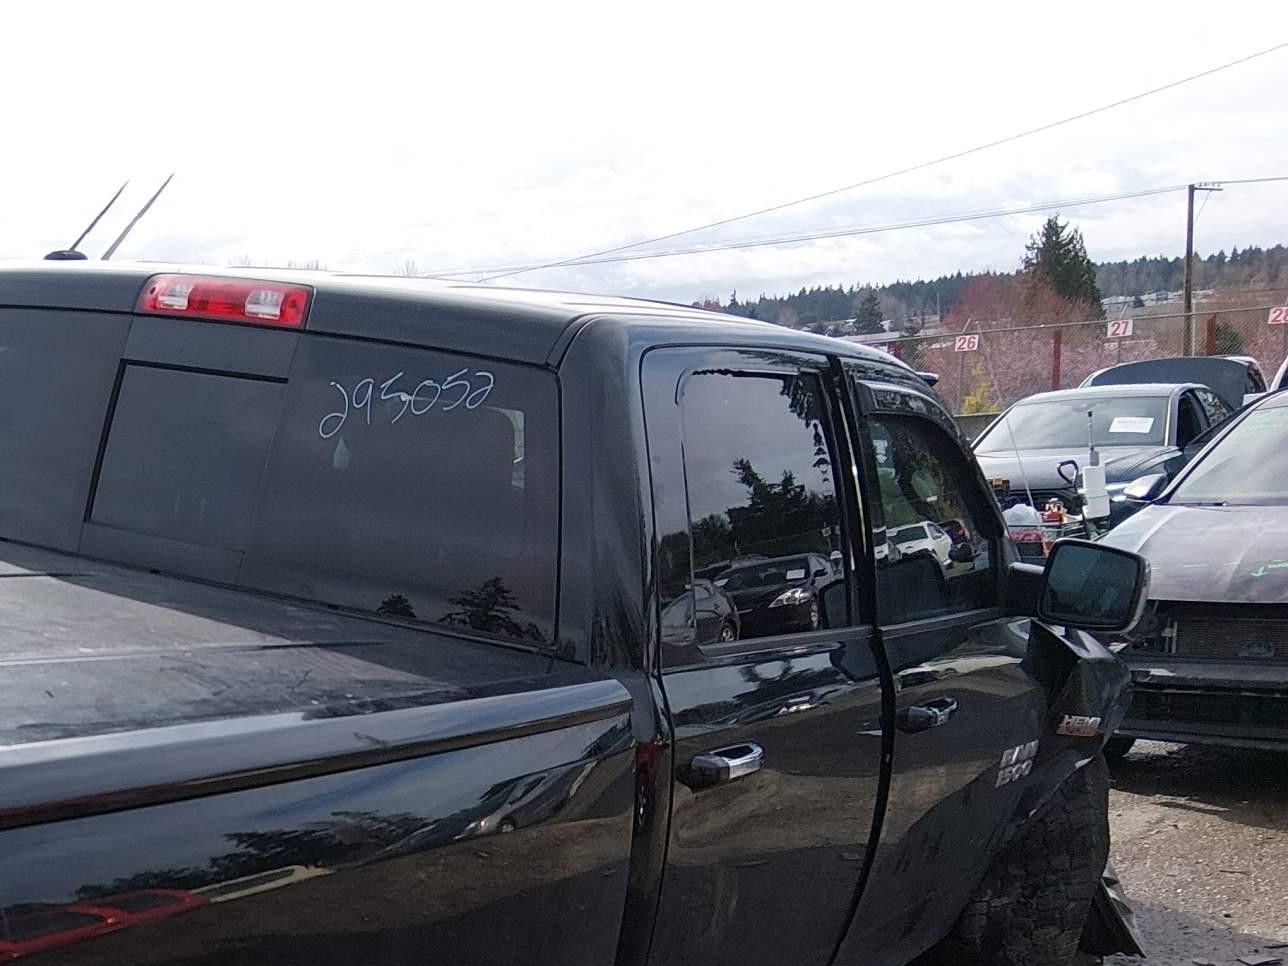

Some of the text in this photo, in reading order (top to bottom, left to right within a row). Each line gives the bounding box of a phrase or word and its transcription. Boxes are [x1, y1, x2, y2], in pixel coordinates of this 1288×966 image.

[1111, 320, 1129, 336] 27
[958, 336, 976, 349] 26
[319, 368, 494, 438] 295052
[1059, 714, 1101, 729] HEMI
[995, 760, 1032, 789] 1500
